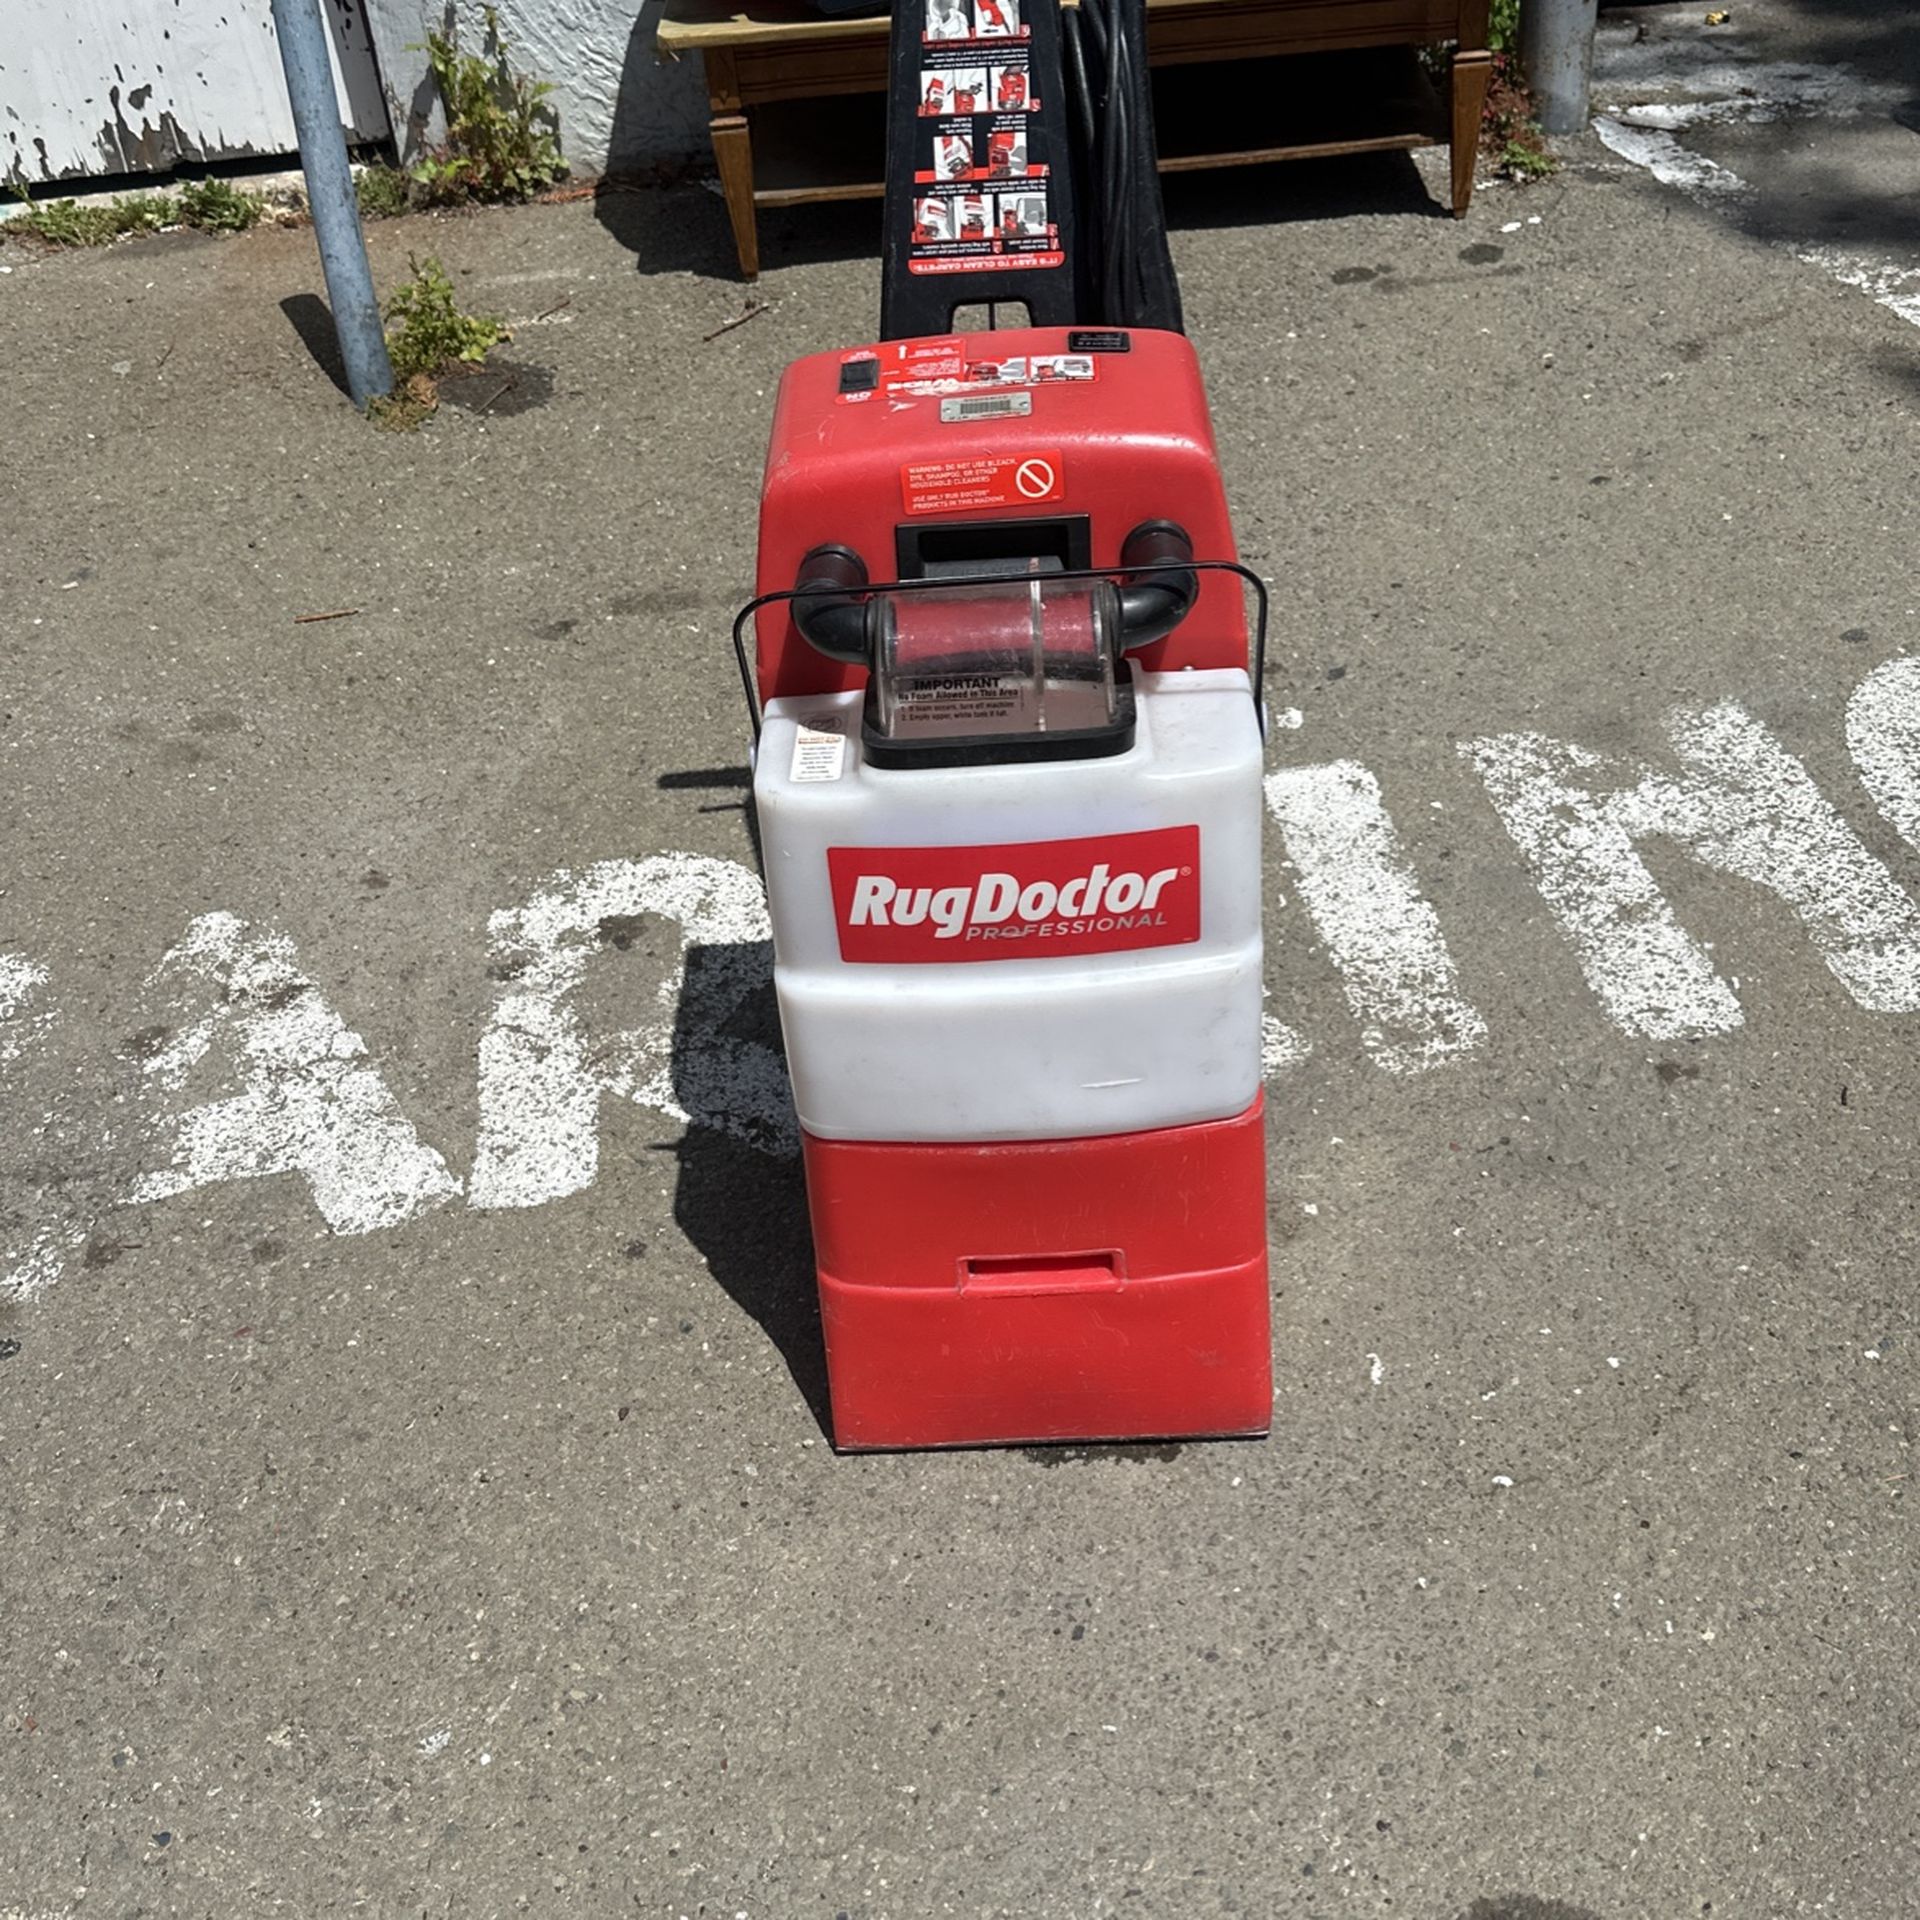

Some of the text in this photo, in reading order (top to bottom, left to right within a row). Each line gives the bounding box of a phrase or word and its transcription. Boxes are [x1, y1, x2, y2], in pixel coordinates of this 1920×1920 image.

[963, 261, 996, 270] CLEAN
[997, 260, 1012, 268] TO
[1012, 258, 1038, 267] EASY
[914, 678, 1000, 690] IMPORTANT
[911, 692, 933, 700] Foam
[936, 691, 968, 699] Allowed
[980, 689, 997, 697] This
[999, 688, 1018, 696] Area
[965, 912, 1168, 941] PROFESSIONAL
